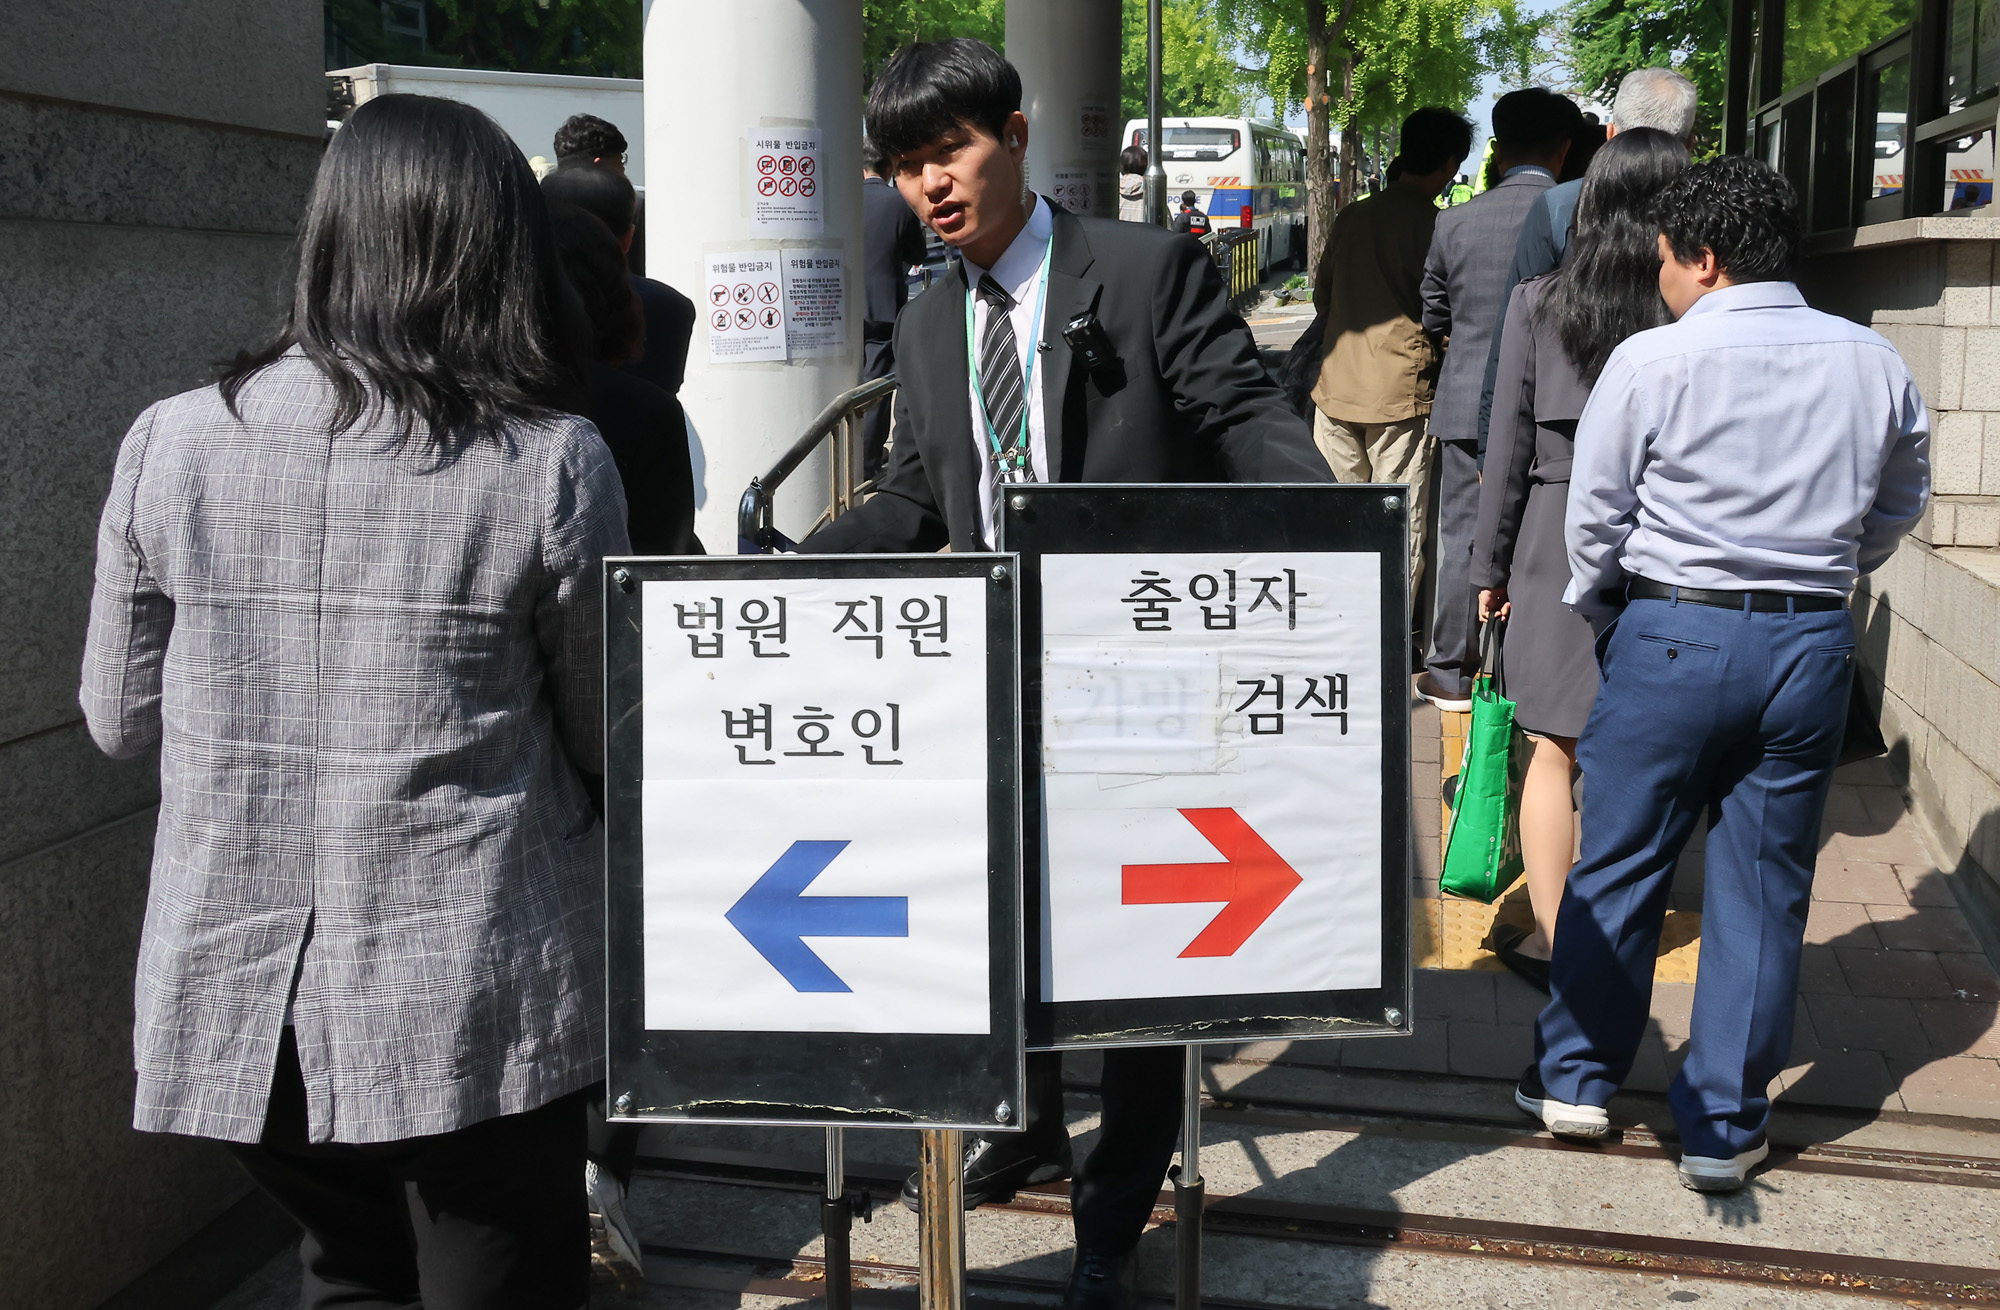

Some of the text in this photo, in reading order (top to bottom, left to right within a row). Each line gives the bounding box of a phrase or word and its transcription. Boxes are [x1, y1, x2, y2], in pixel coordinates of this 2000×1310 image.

[757, 140, 781, 149] 시위물
[713, 262, 772, 273] 위험물 반입금지
[791, 259, 840, 268] 위험물 반입금지
[674, 595, 951, 659] 법원 직원
[1121, 568, 1308, 632] 출입자
[721, 703, 904, 766] 변호인
[1234, 673, 1348, 736] 검색
